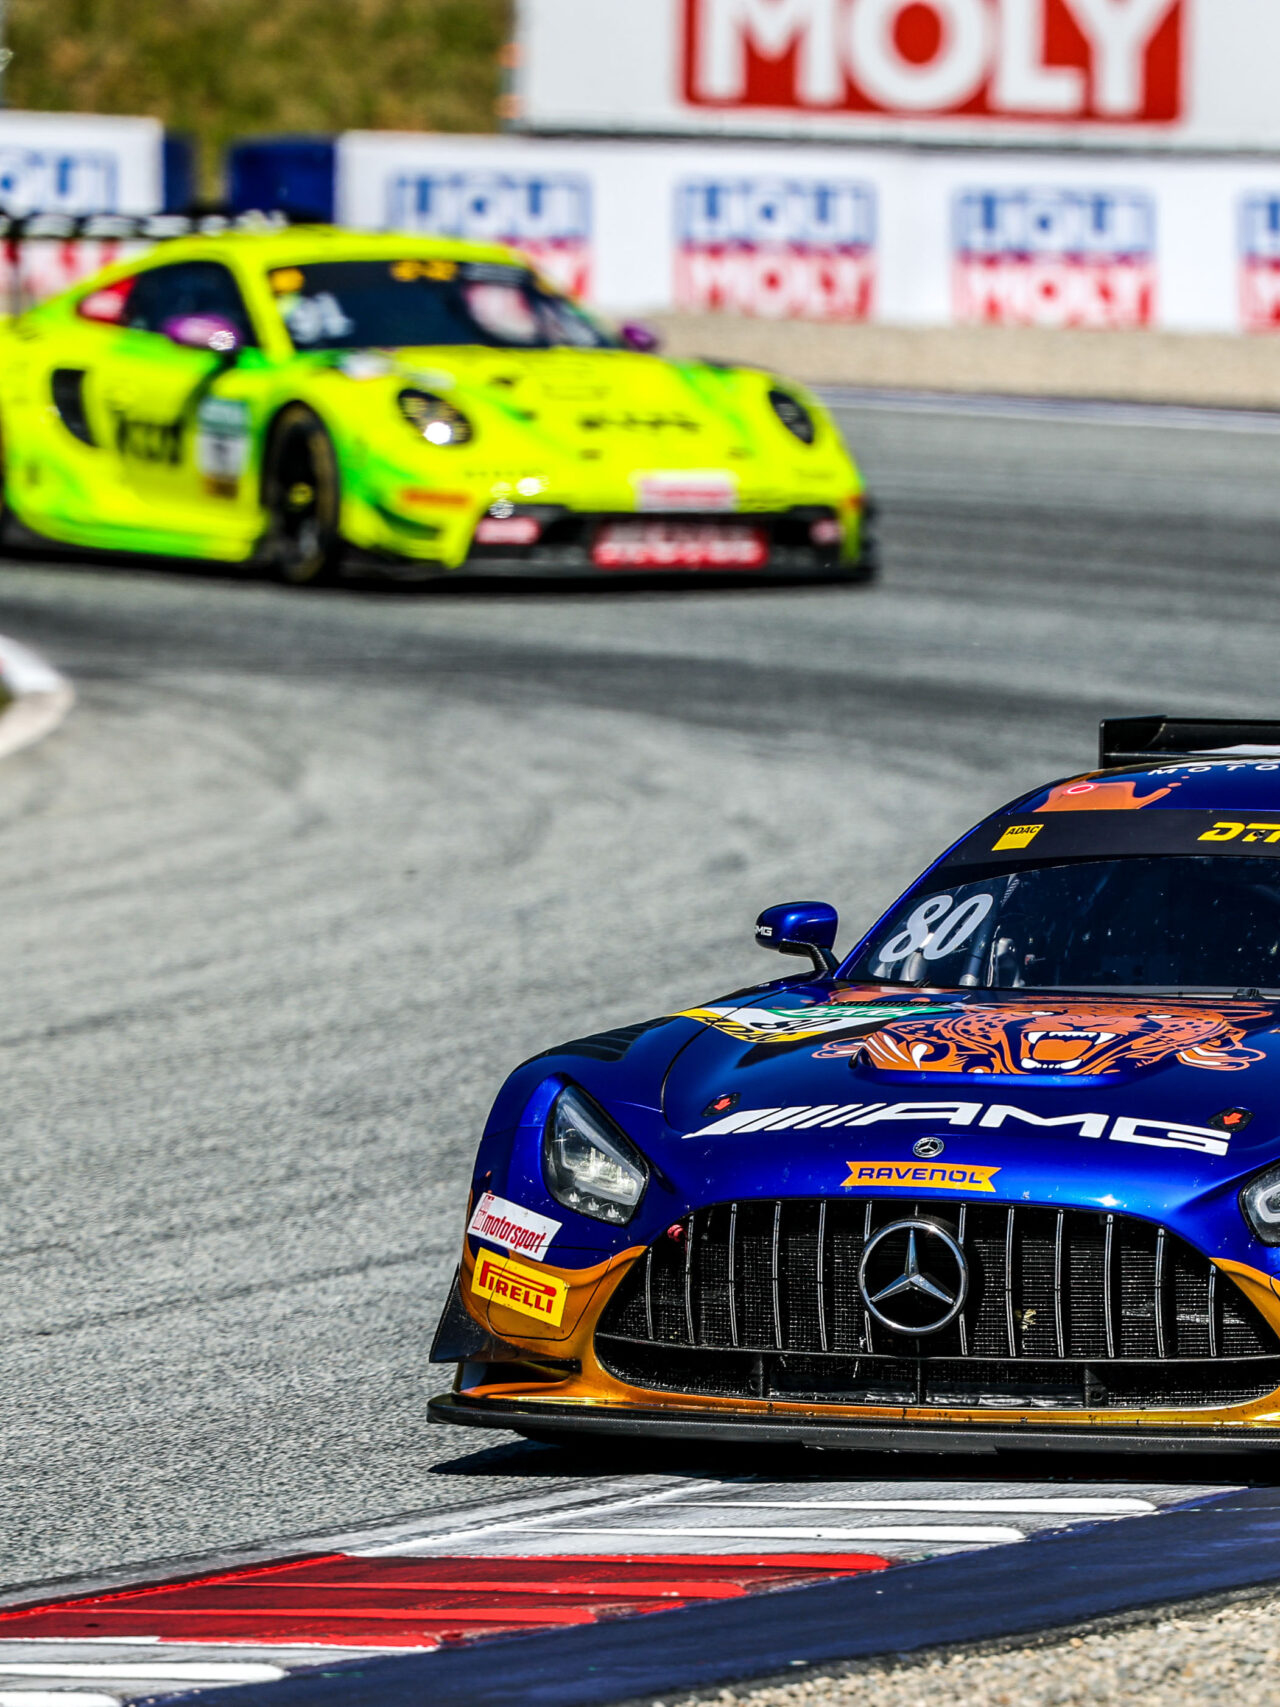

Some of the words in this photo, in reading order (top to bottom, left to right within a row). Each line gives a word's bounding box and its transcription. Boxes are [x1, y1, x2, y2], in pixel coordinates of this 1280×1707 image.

[695, 0, 1177, 118] MOLY
[1005, 825, 1040, 836] ADAC
[754, 925, 773, 936] MG
[879, 893, 993, 963] 80
[846, 1101, 1232, 1156] AMG
[857, 1167, 983, 1184] RAVENOL
[481, 1214, 547, 1254] motorsport
[479, 1260, 557, 1314] PIRELLI
